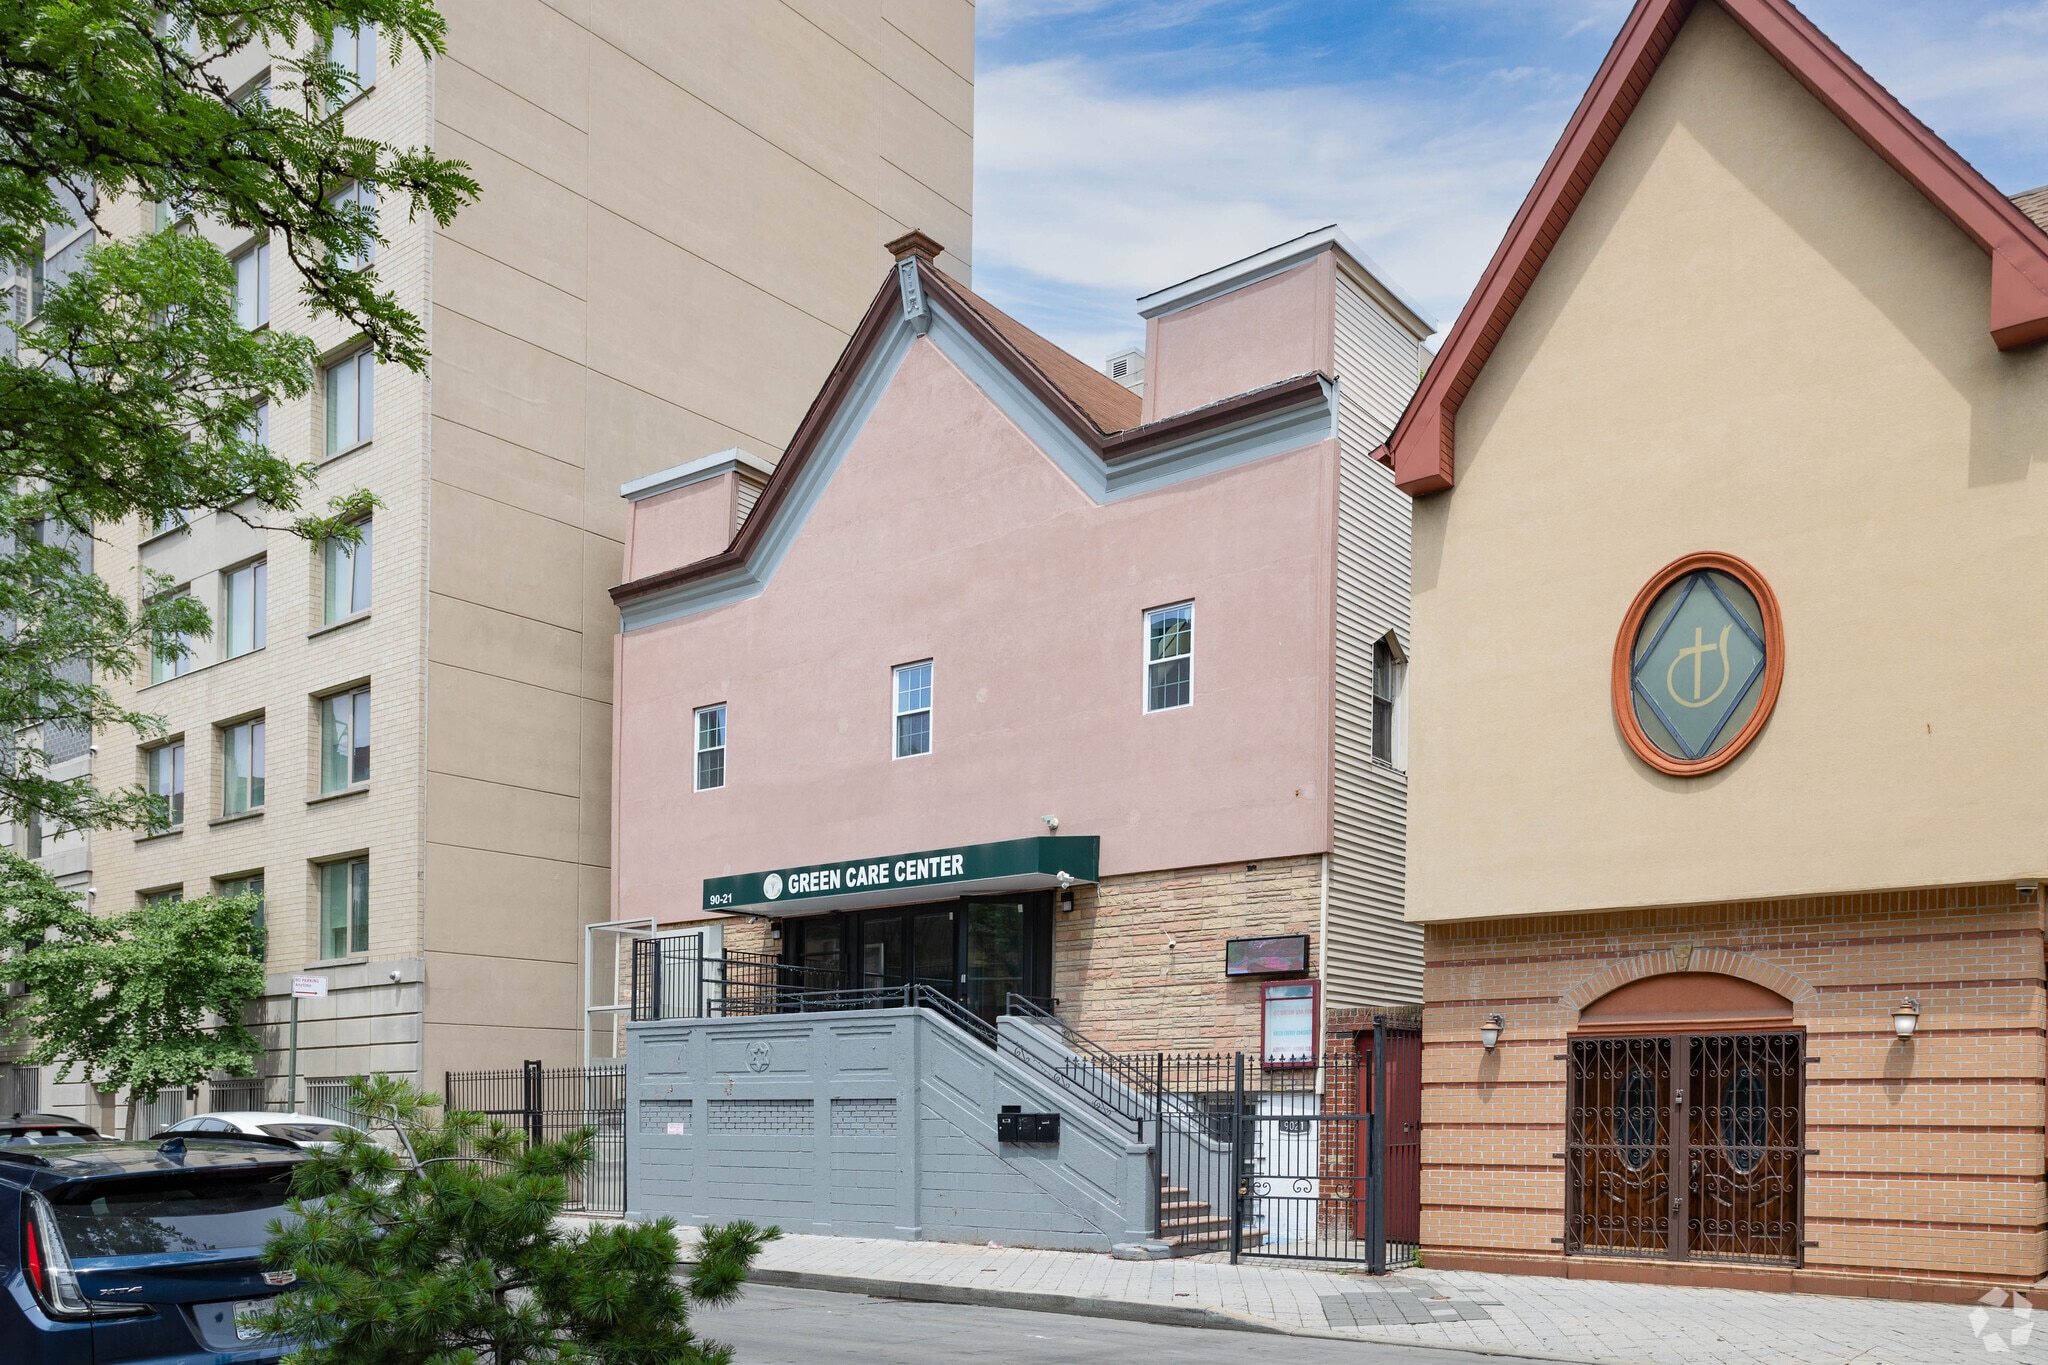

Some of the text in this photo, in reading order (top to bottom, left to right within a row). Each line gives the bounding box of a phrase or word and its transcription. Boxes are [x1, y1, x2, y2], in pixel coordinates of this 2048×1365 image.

[788, 854, 964, 894] GREEN CARE CENTER
[709, 893, 732, 906] 90-21
[1284, 1121, 1304, 1131] 9021
